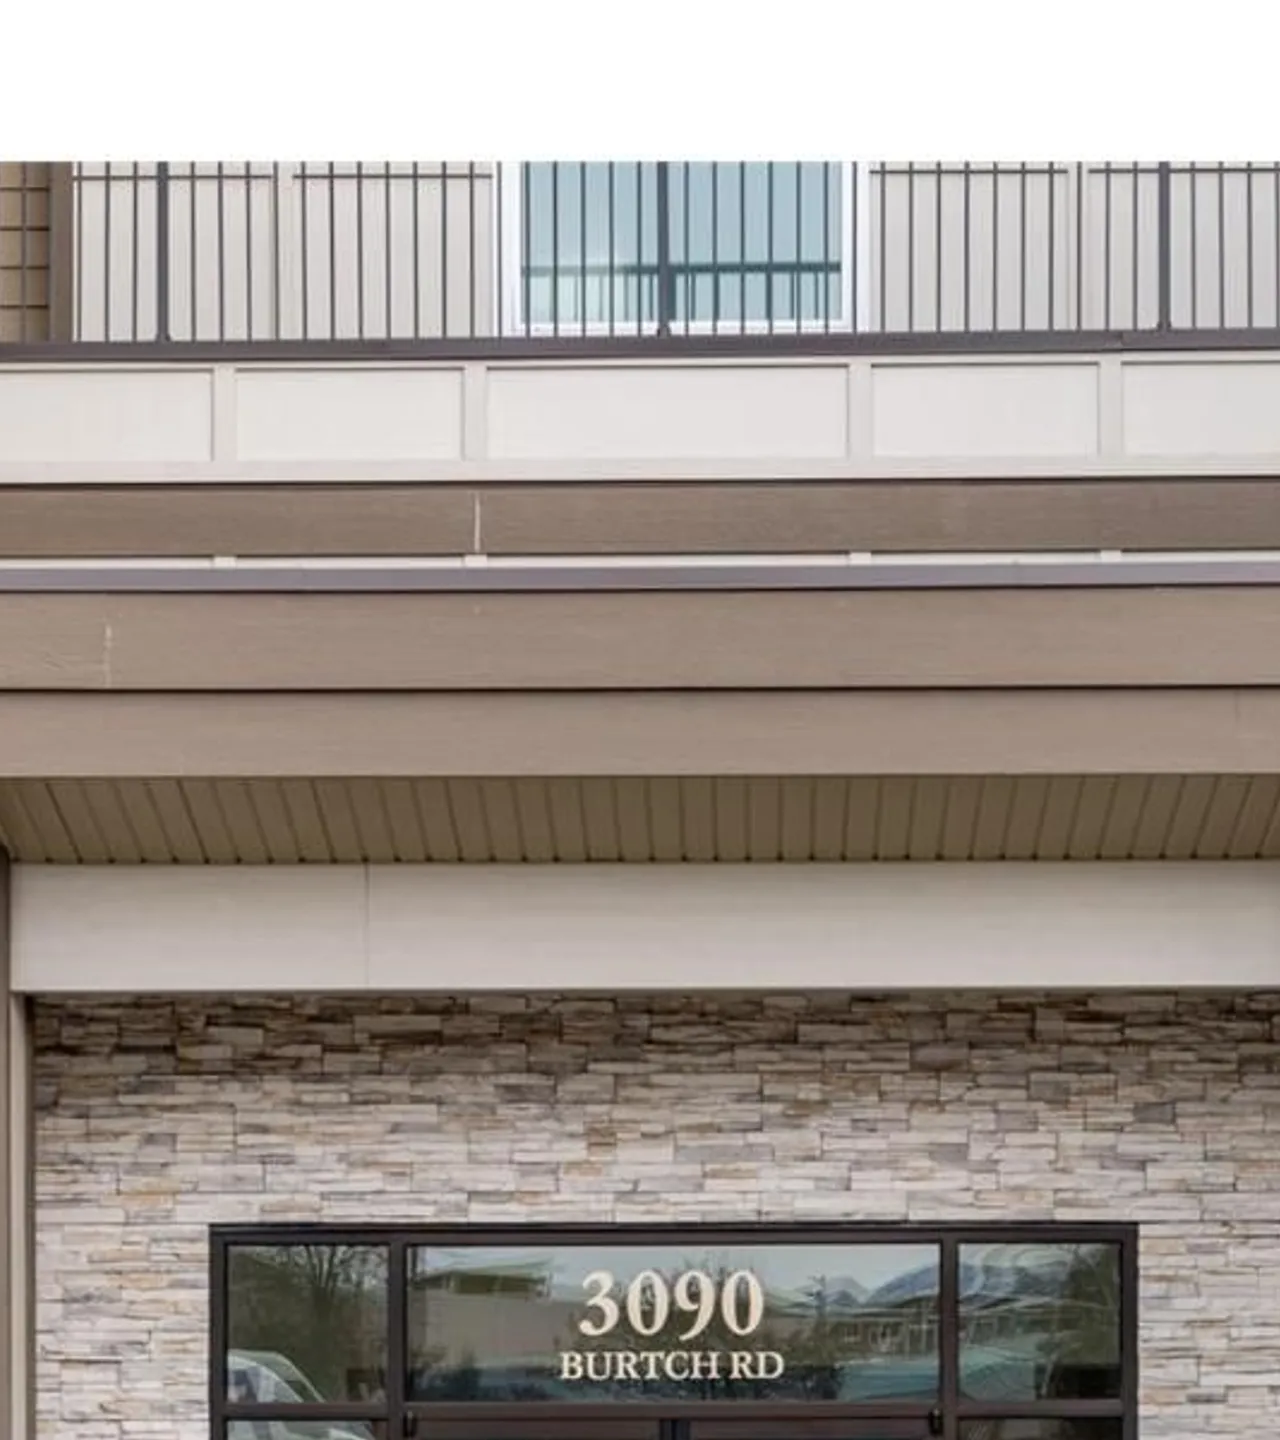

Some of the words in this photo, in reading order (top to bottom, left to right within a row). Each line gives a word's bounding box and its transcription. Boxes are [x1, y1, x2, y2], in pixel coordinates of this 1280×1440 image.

[577, 1268, 765, 1342] 3090
[560, 1350, 721, 1381] BURTCH
[728, 1350, 785, 1381] RD
